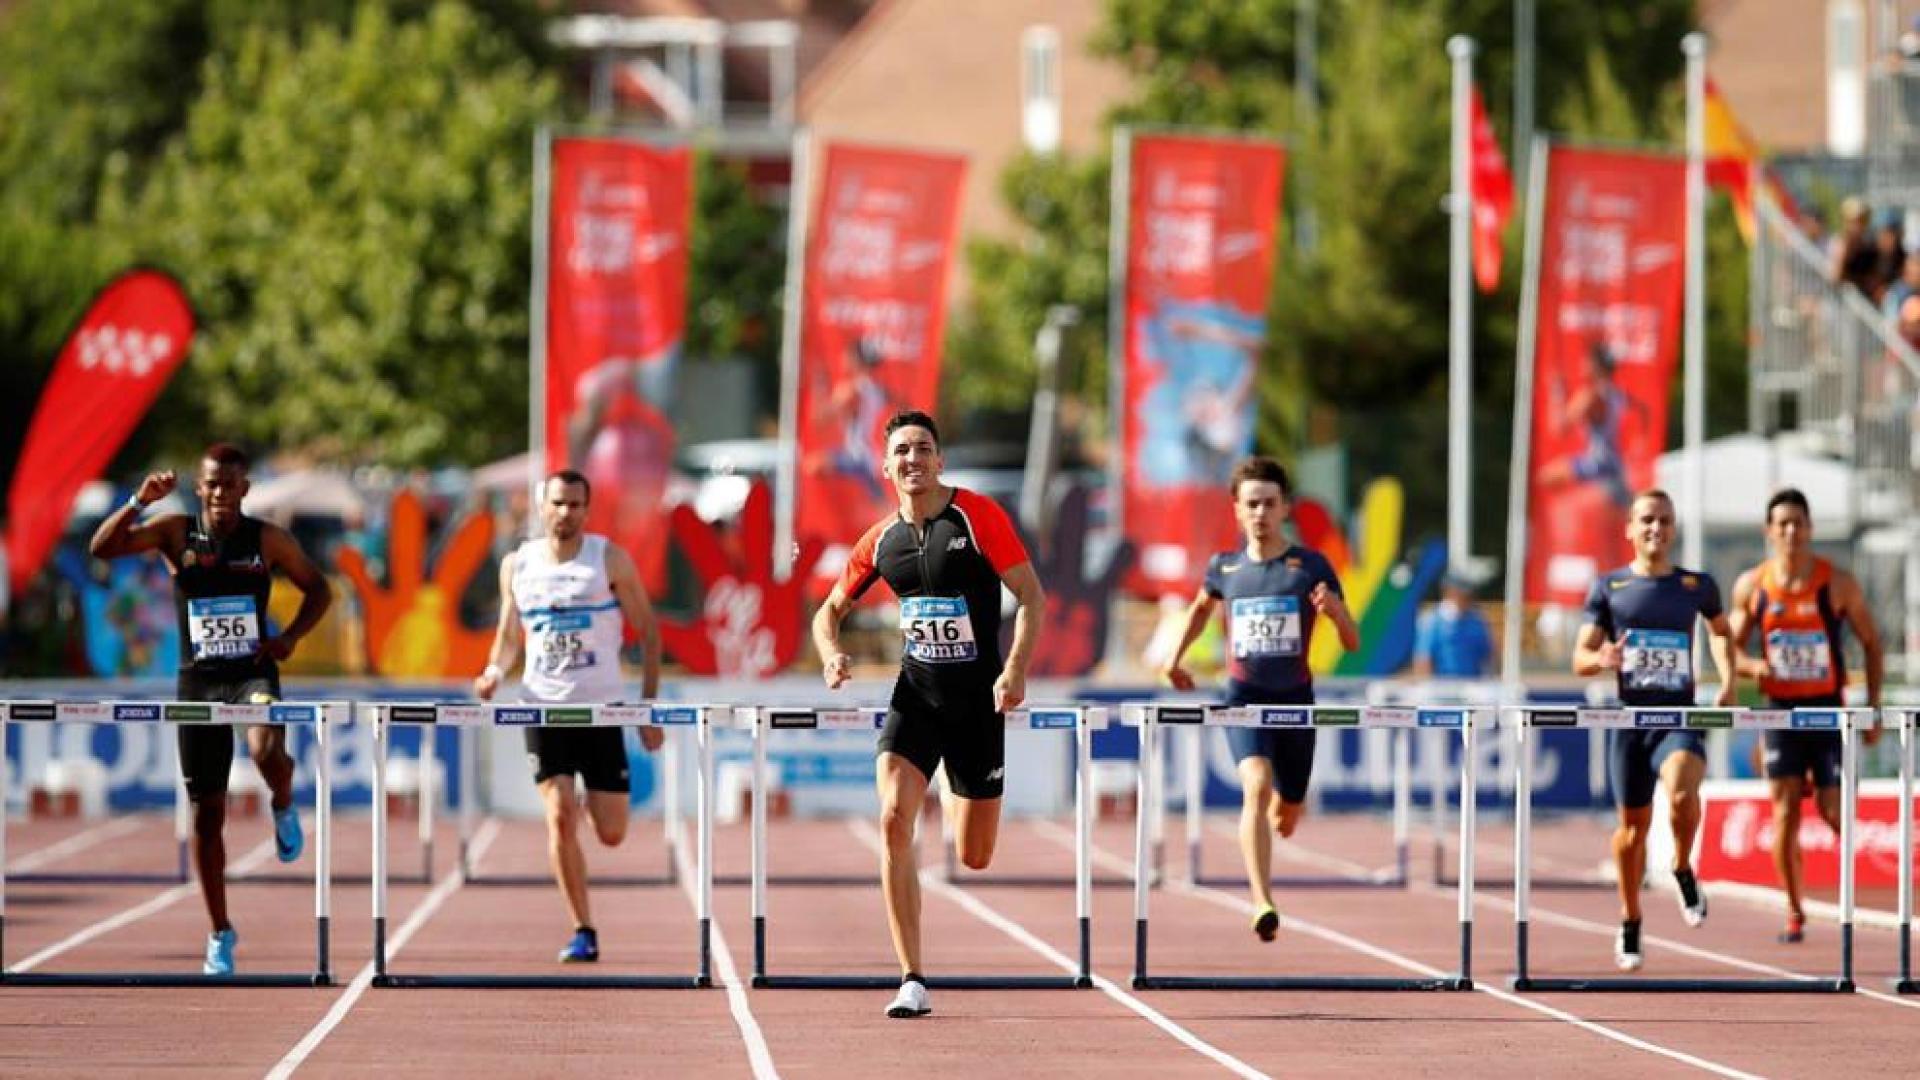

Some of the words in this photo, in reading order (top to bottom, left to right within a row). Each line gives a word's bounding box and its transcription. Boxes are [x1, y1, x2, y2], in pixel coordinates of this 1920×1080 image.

[202, 616, 246, 639] 556
[911, 620, 960, 642] 516
[1248, 616, 1286, 637] 367
[1637, 650, 1676, 669] 353
